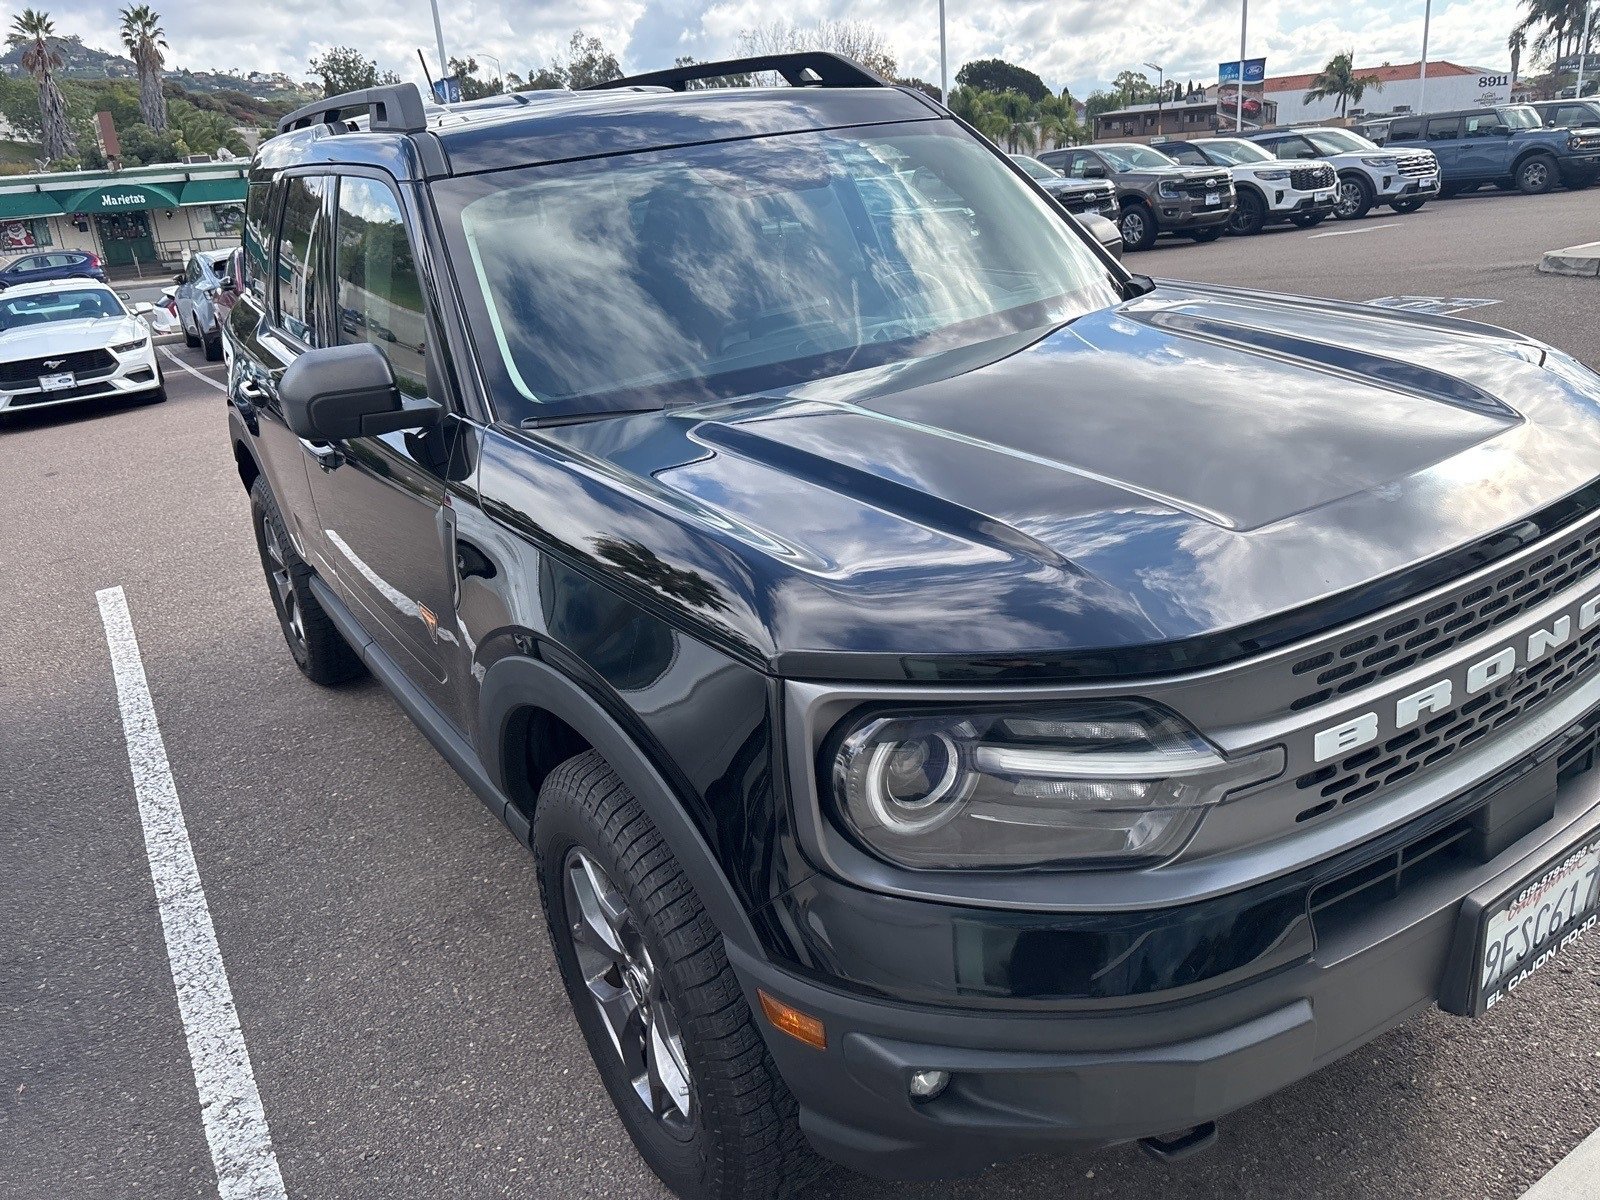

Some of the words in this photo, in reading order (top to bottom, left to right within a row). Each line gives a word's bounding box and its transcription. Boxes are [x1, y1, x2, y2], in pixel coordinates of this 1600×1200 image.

[1478, 75, 1508, 88] 8911
[101, 194, 146, 206] Marieta's
[1486, 989, 1504, 1009] EL
[1508, 946, 1557, 991] CAJON
